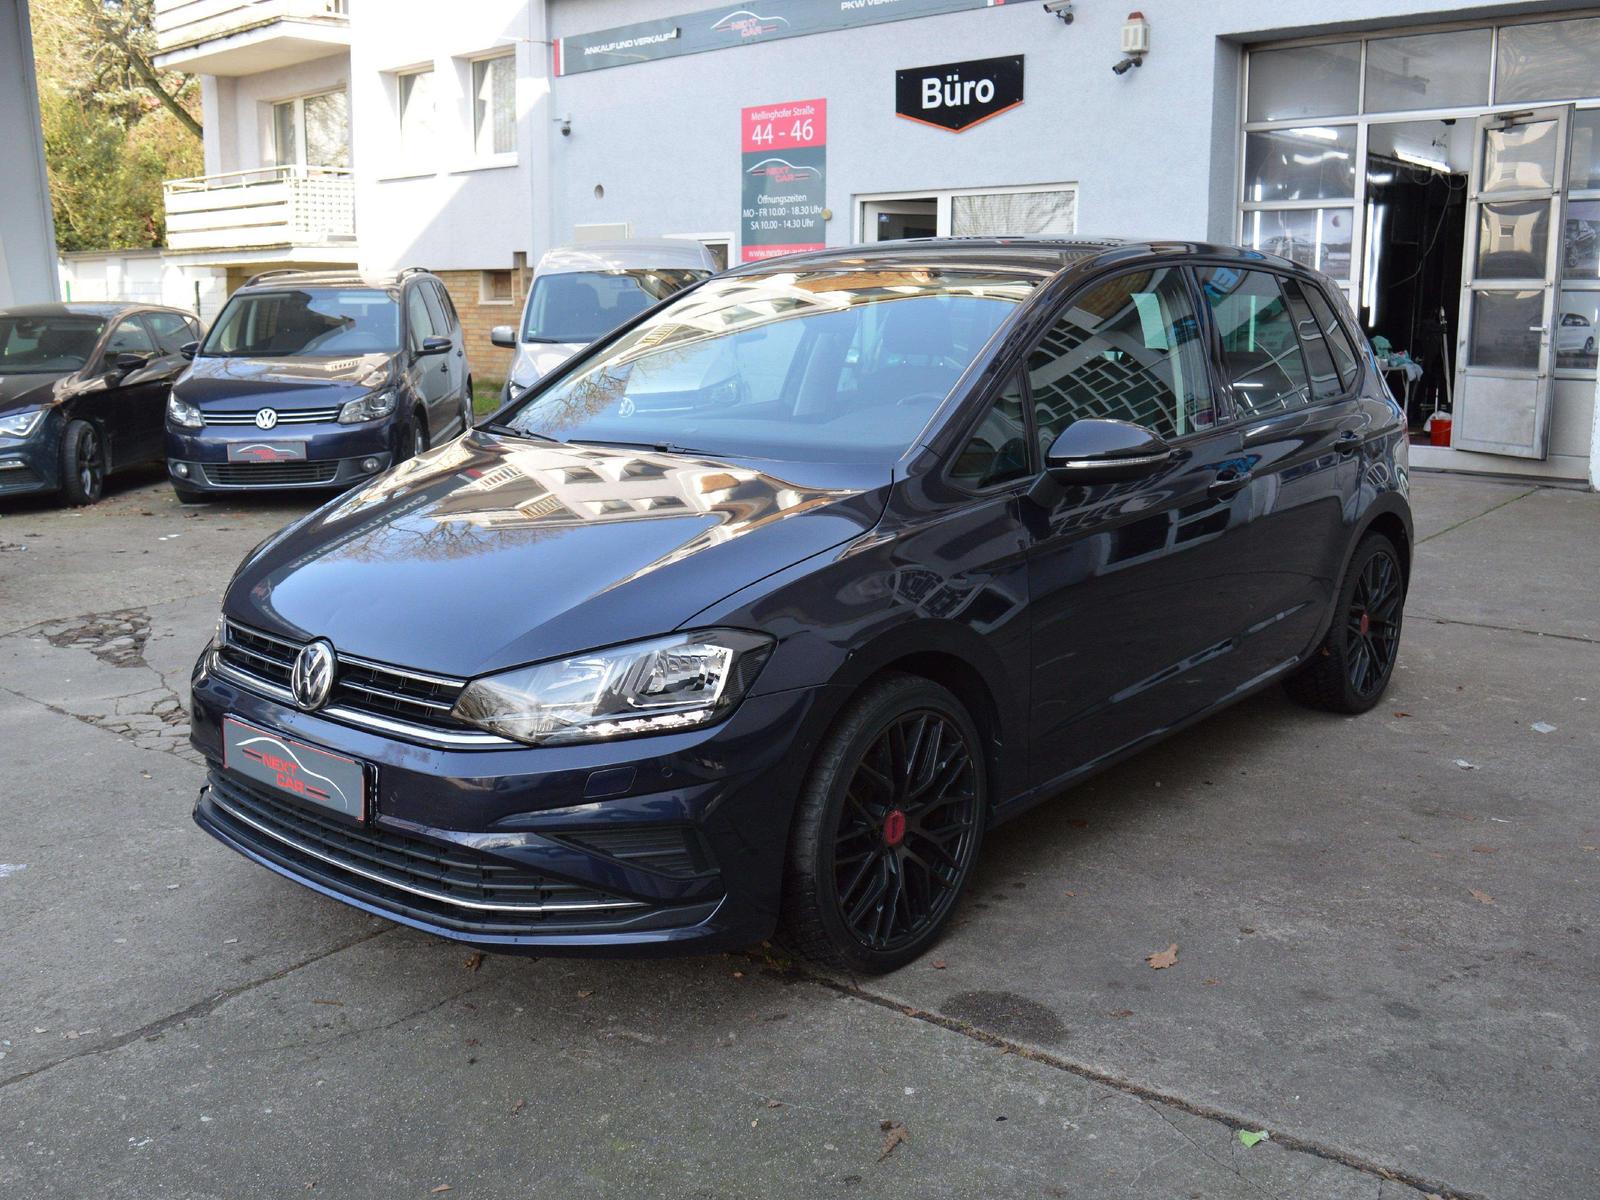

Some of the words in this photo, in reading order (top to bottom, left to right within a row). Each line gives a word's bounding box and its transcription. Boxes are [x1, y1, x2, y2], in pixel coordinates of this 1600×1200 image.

[584, 43, 616, 56] ANKAUF
[616, 39, 633, 50] UND
[922, 74, 995, 109] Büro
[792, 105, 815, 117] Straße
[751, 123, 774, 145] 44
[790, 118, 814, 142] 46
[757, 193, 807, 205] Öffnungszeiten
[743, 208, 755, 218] MO
[759, 208, 768, 217] FR
[769, 207, 786, 216] 10.00
[791, 206, 809, 215] 18.30
[810, 205, 823, 214] Uhr
[750, 221, 759, 230] SA
[761, 220, 778, 229] 10.00
[783, 219, 801, 228] 14.30
[802, 218, 814, 228] Uhr
[262, 752, 298, 775] NEXT
[276, 773, 305, 793] CAR
